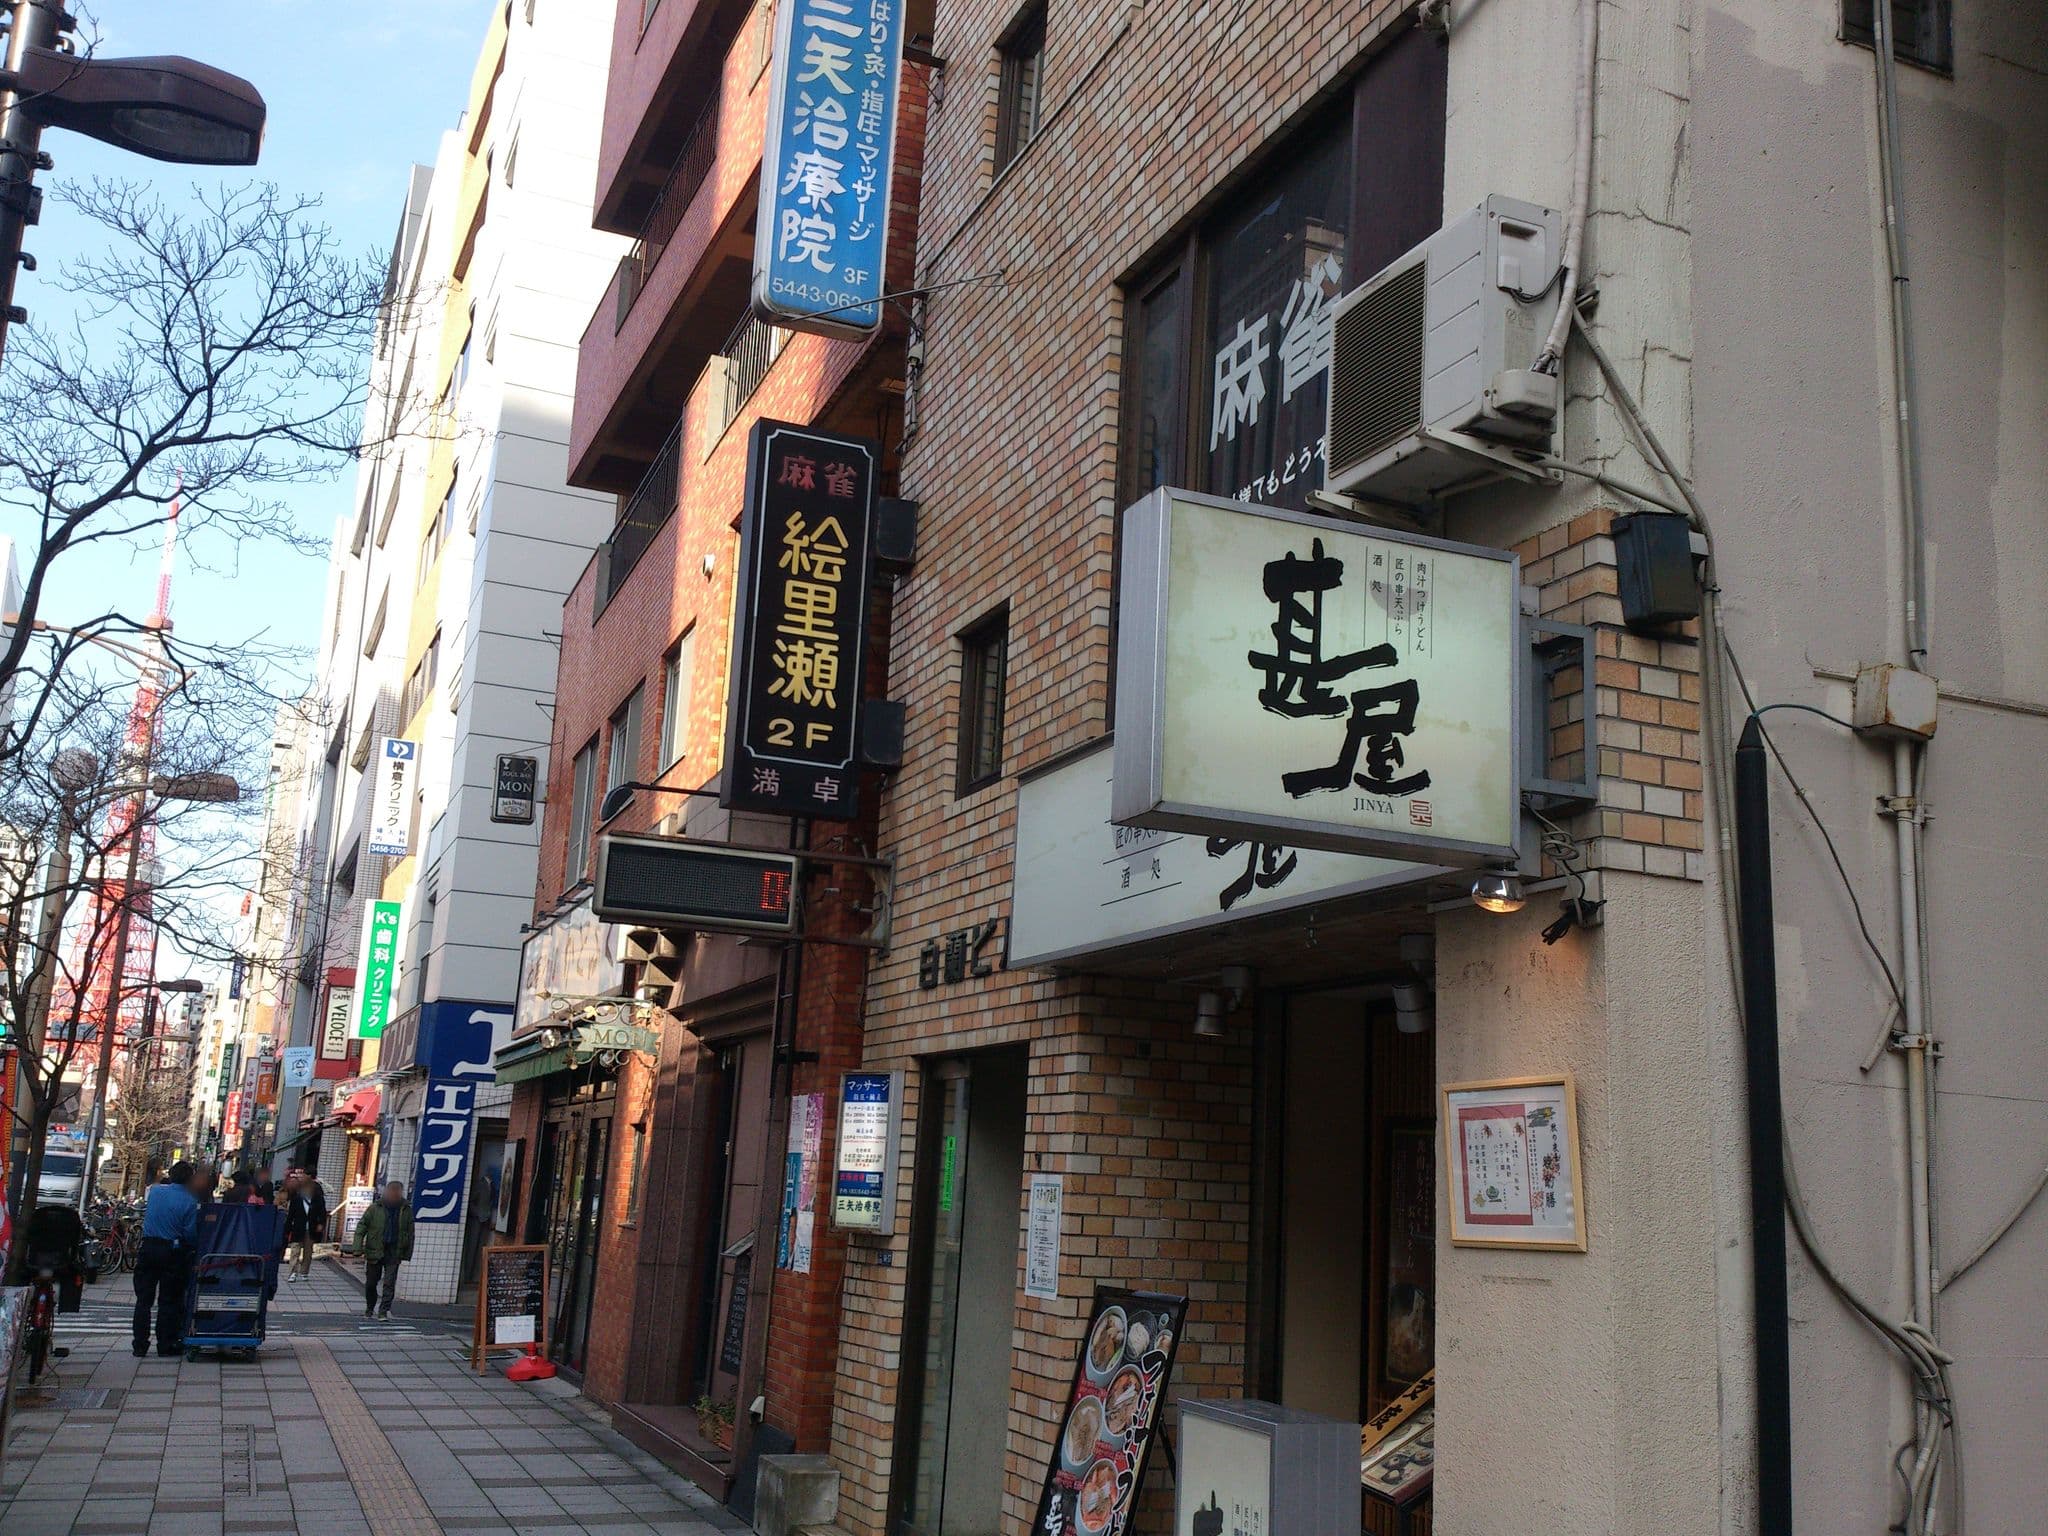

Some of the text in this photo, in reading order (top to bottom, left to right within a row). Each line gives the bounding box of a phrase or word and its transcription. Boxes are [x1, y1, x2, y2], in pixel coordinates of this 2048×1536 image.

[844, 267, 868, 285] 3F
[772, 277, 873, 315] 5443-0624
[1209, 252, 1342, 453] 麻雀
[777, 455, 858, 498] 麻雀
[768, 511, 849, 709] 絵里瀬
[767, 718, 833, 749] 2F
[499, 780, 531, 793] MON
[1353, 798, 1394, 814] JINYA
[375, 910, 398, 925] K's
[367, 928, 393, 1028] 歯科クリニック
[328, 1004, 348, 1042] VELOCE
[593, 1029, 648, 1046] MON
[847, 1079, 890, 1091] マッサージ
[416, 1084, 471, 1219] エフワン
